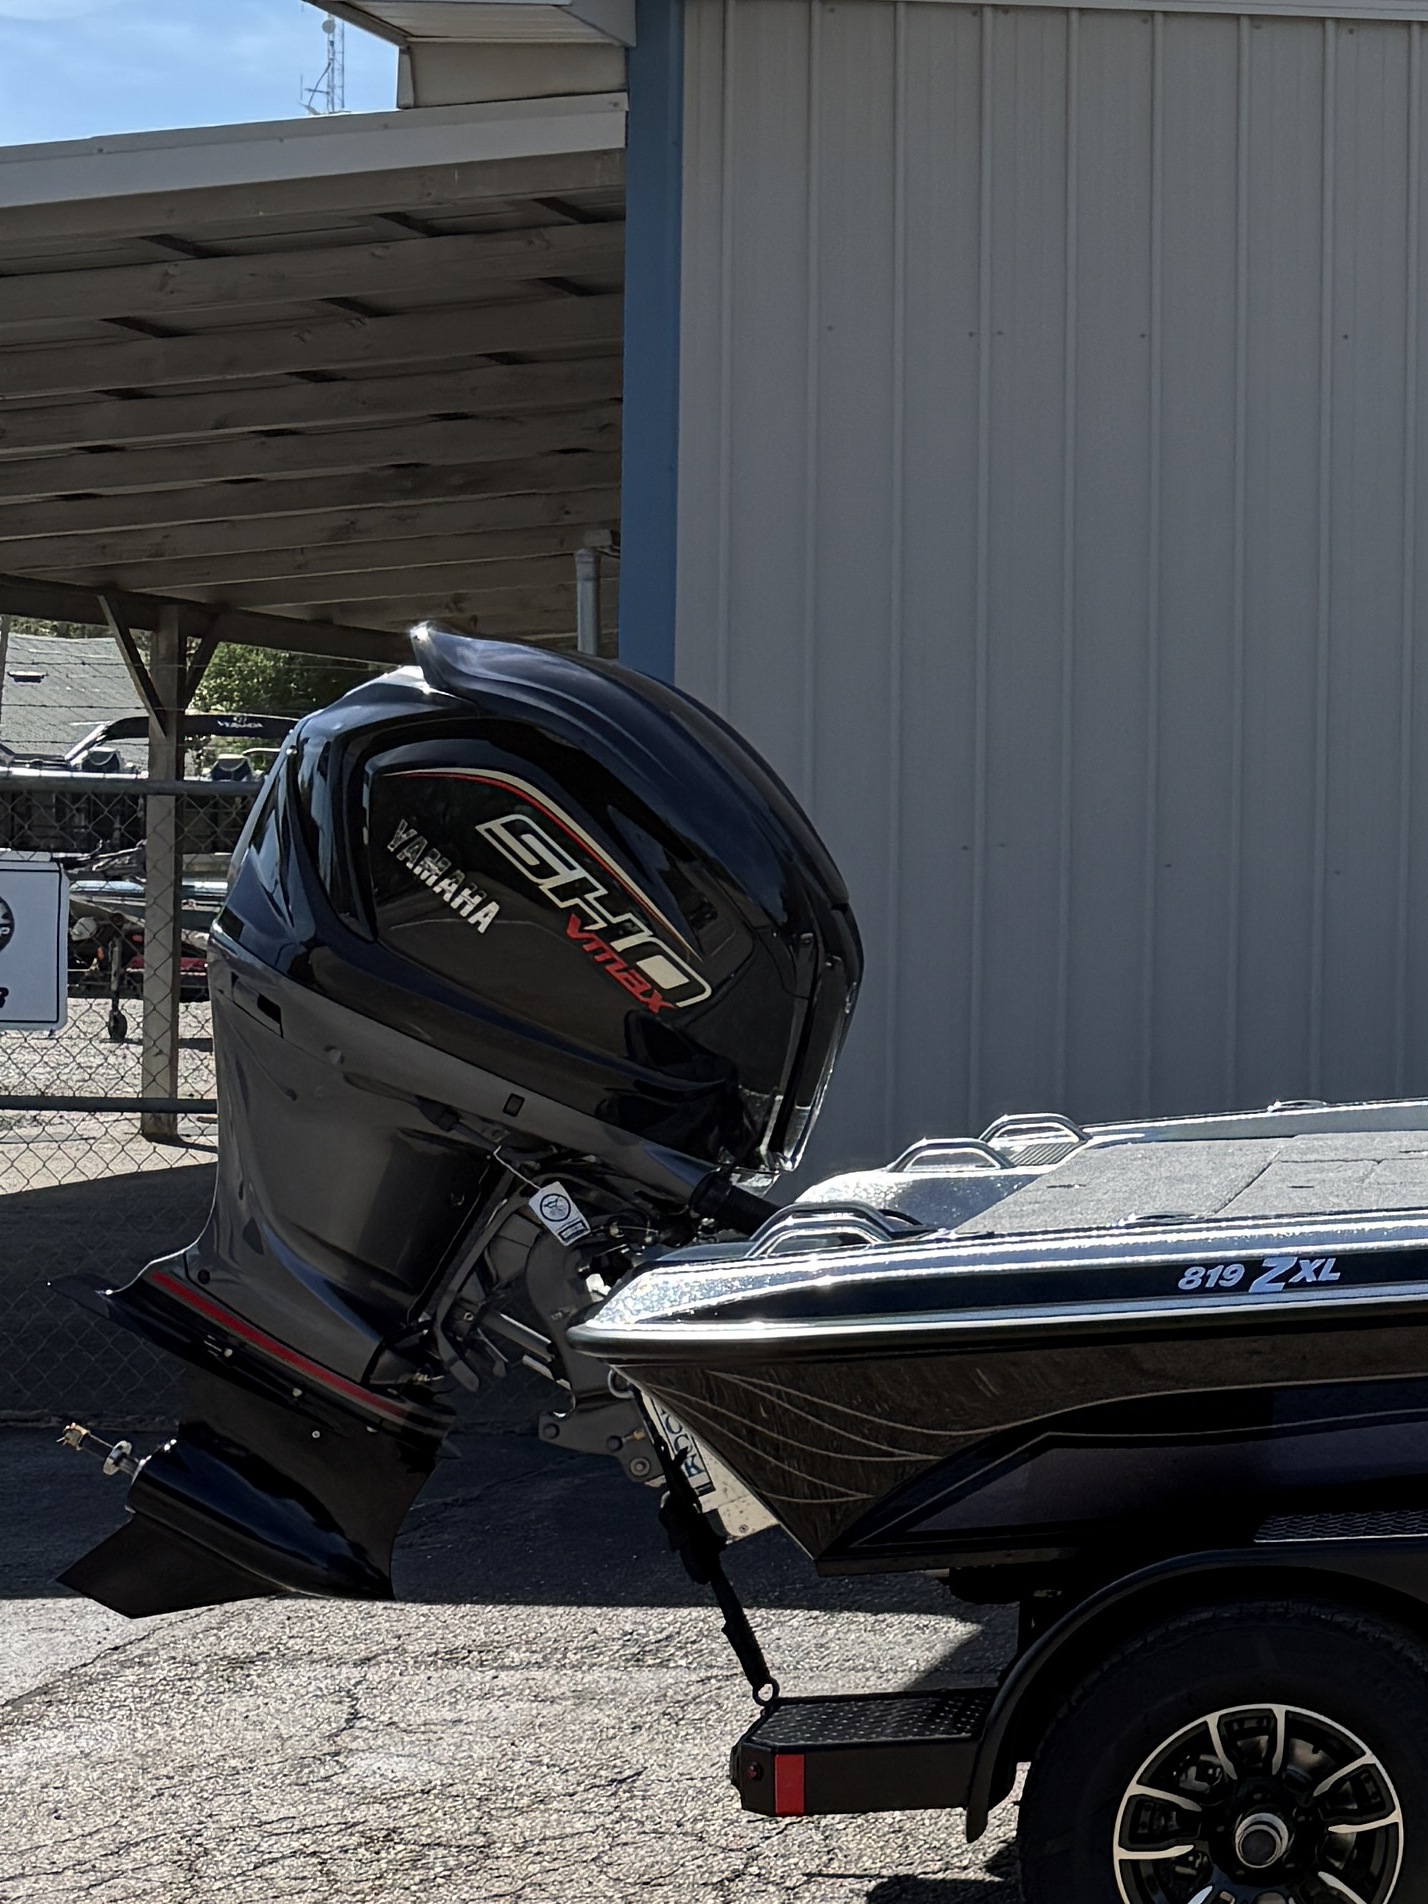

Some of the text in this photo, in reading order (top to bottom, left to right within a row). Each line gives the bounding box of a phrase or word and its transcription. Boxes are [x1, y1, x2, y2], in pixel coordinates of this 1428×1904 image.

[386, 818, 500, 934] YAMAHA
[474, 813, 713, 1008] SHO
[1177, 1263, 1245, 1290] 819
